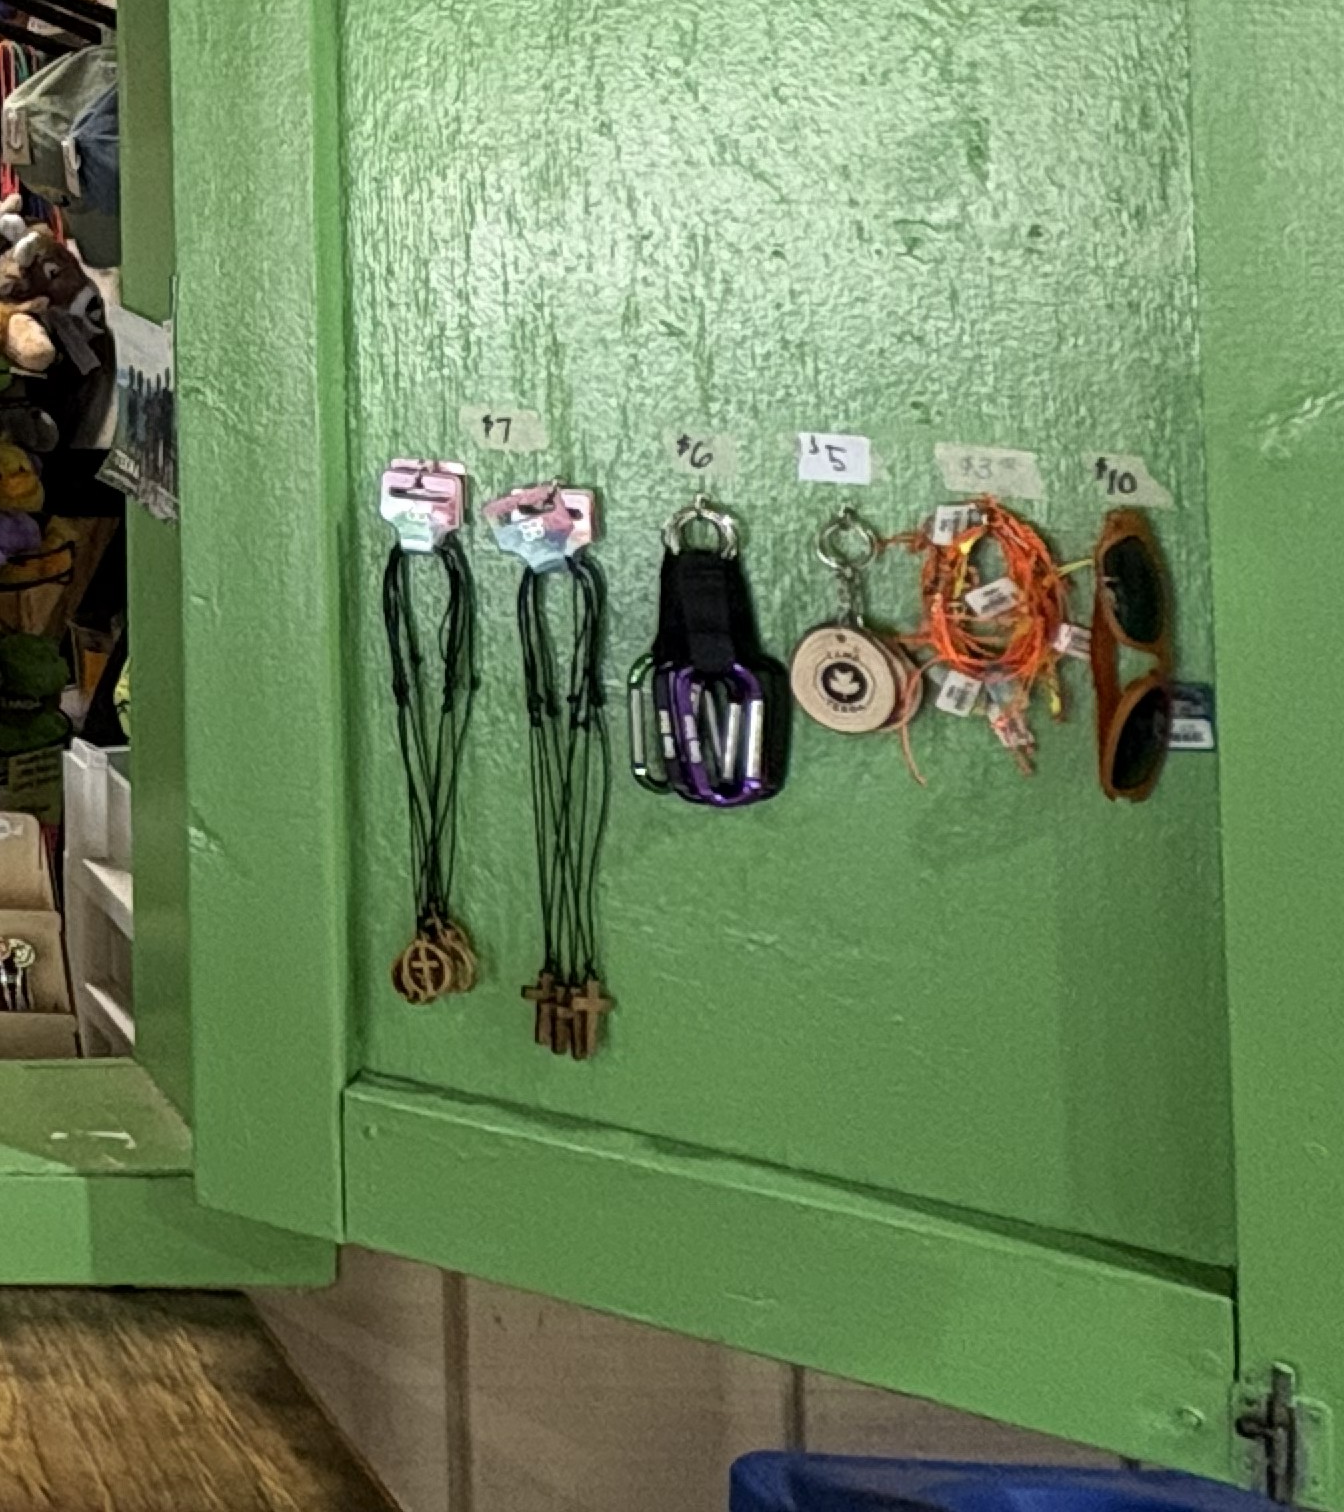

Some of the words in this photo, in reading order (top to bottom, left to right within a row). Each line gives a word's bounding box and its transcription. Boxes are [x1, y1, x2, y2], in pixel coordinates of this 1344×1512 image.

[481, 414, 513, 444] $7
[676, 434, 714, 469] $6
[807, 434, 849, 473] $5
[1095, 456, 1138, 496] $10
